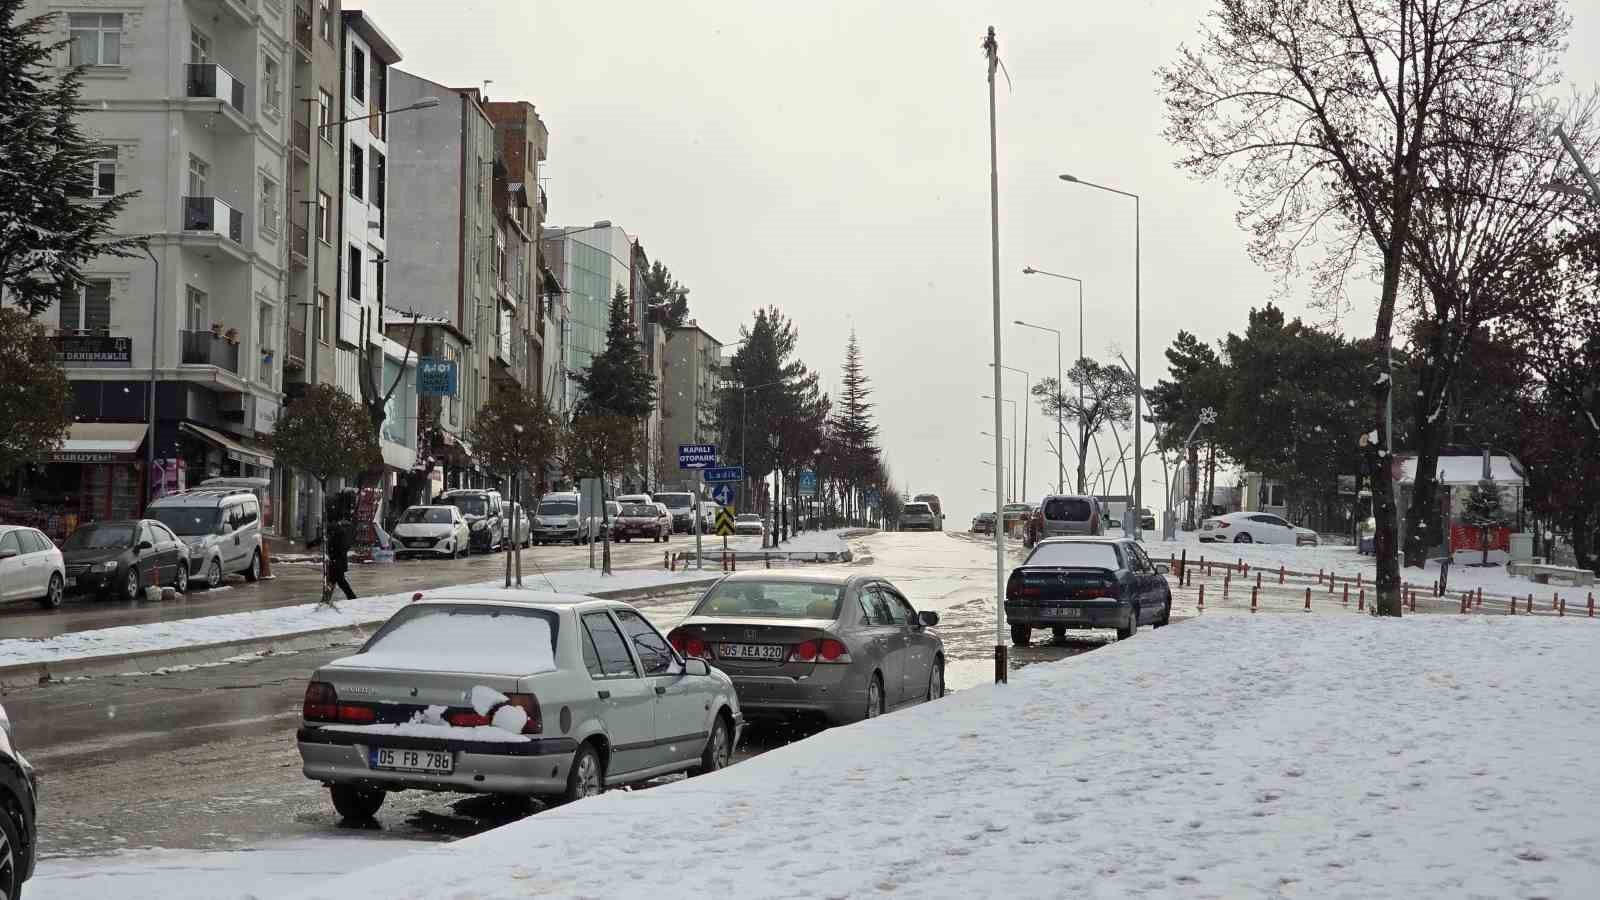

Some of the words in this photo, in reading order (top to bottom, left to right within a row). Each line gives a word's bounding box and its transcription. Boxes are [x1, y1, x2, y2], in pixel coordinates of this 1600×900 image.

[725, 646, 737, 656] 05
[741, 646, 760, 656] AEA
[763, 647, 782, 657] 320
[380, 750, 394, 764] 05
[404, 752, 418, 766] FB
